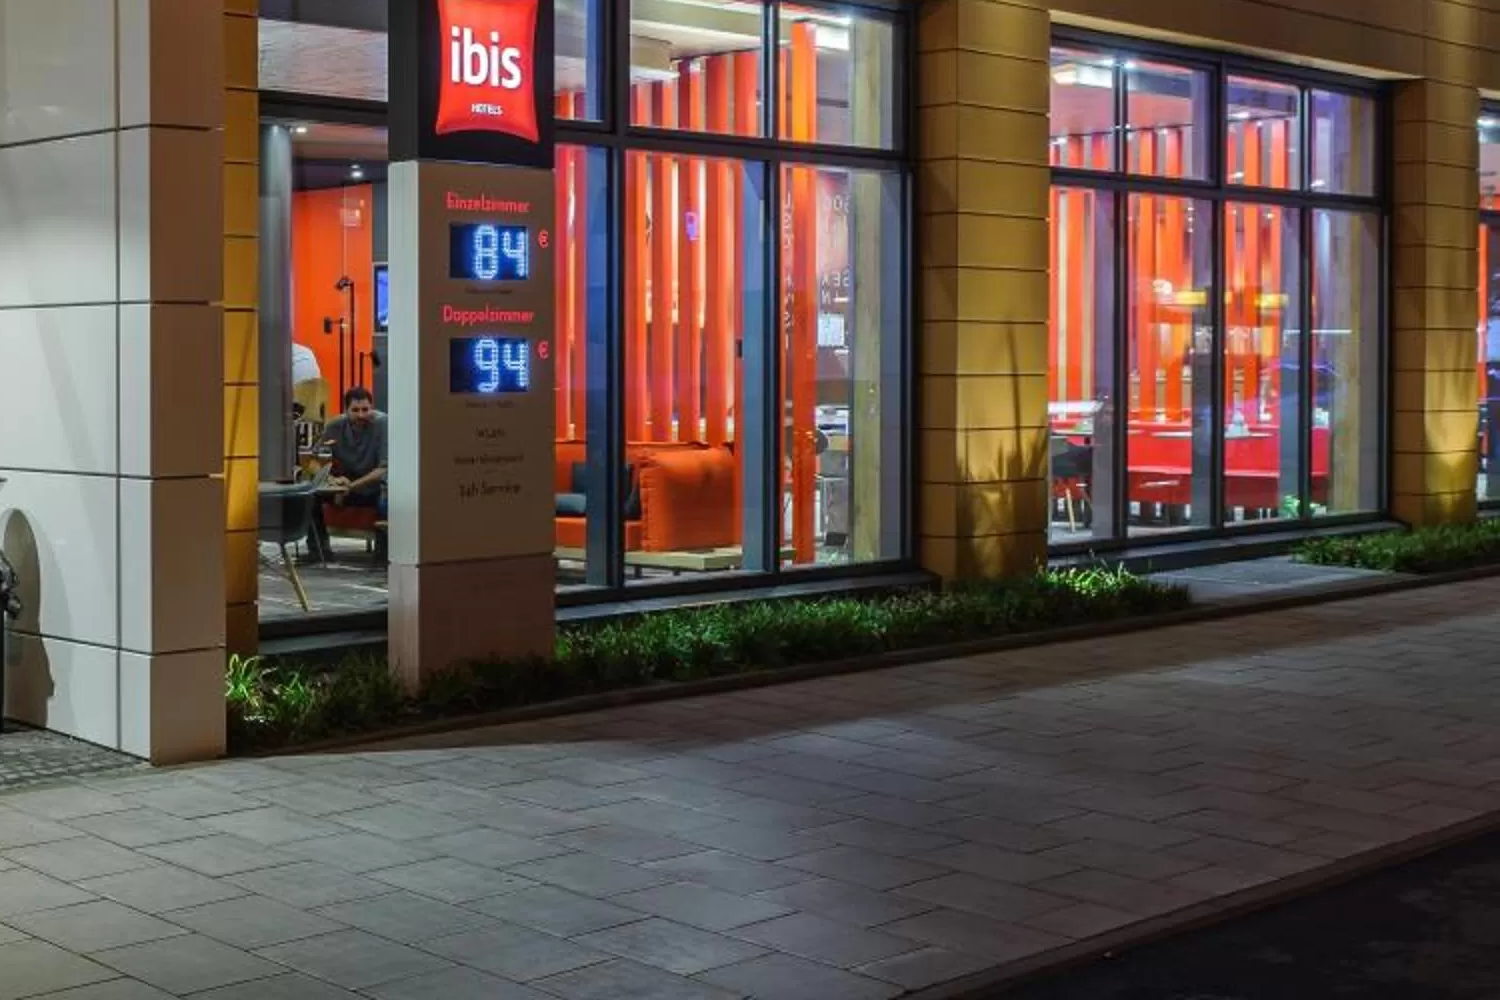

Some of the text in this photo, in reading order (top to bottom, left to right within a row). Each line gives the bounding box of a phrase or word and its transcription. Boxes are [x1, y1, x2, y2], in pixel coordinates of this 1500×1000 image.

[451, 25, 522, 89] ibis
[471, 103, 504, 115] HOTELS
[446, 191, 530, 213] Einzelzimmer
[475, 225, 527, 279] 84
[443, 303, 534, 326] Doppelzimmer
[475, 339, 528, 392] 94
